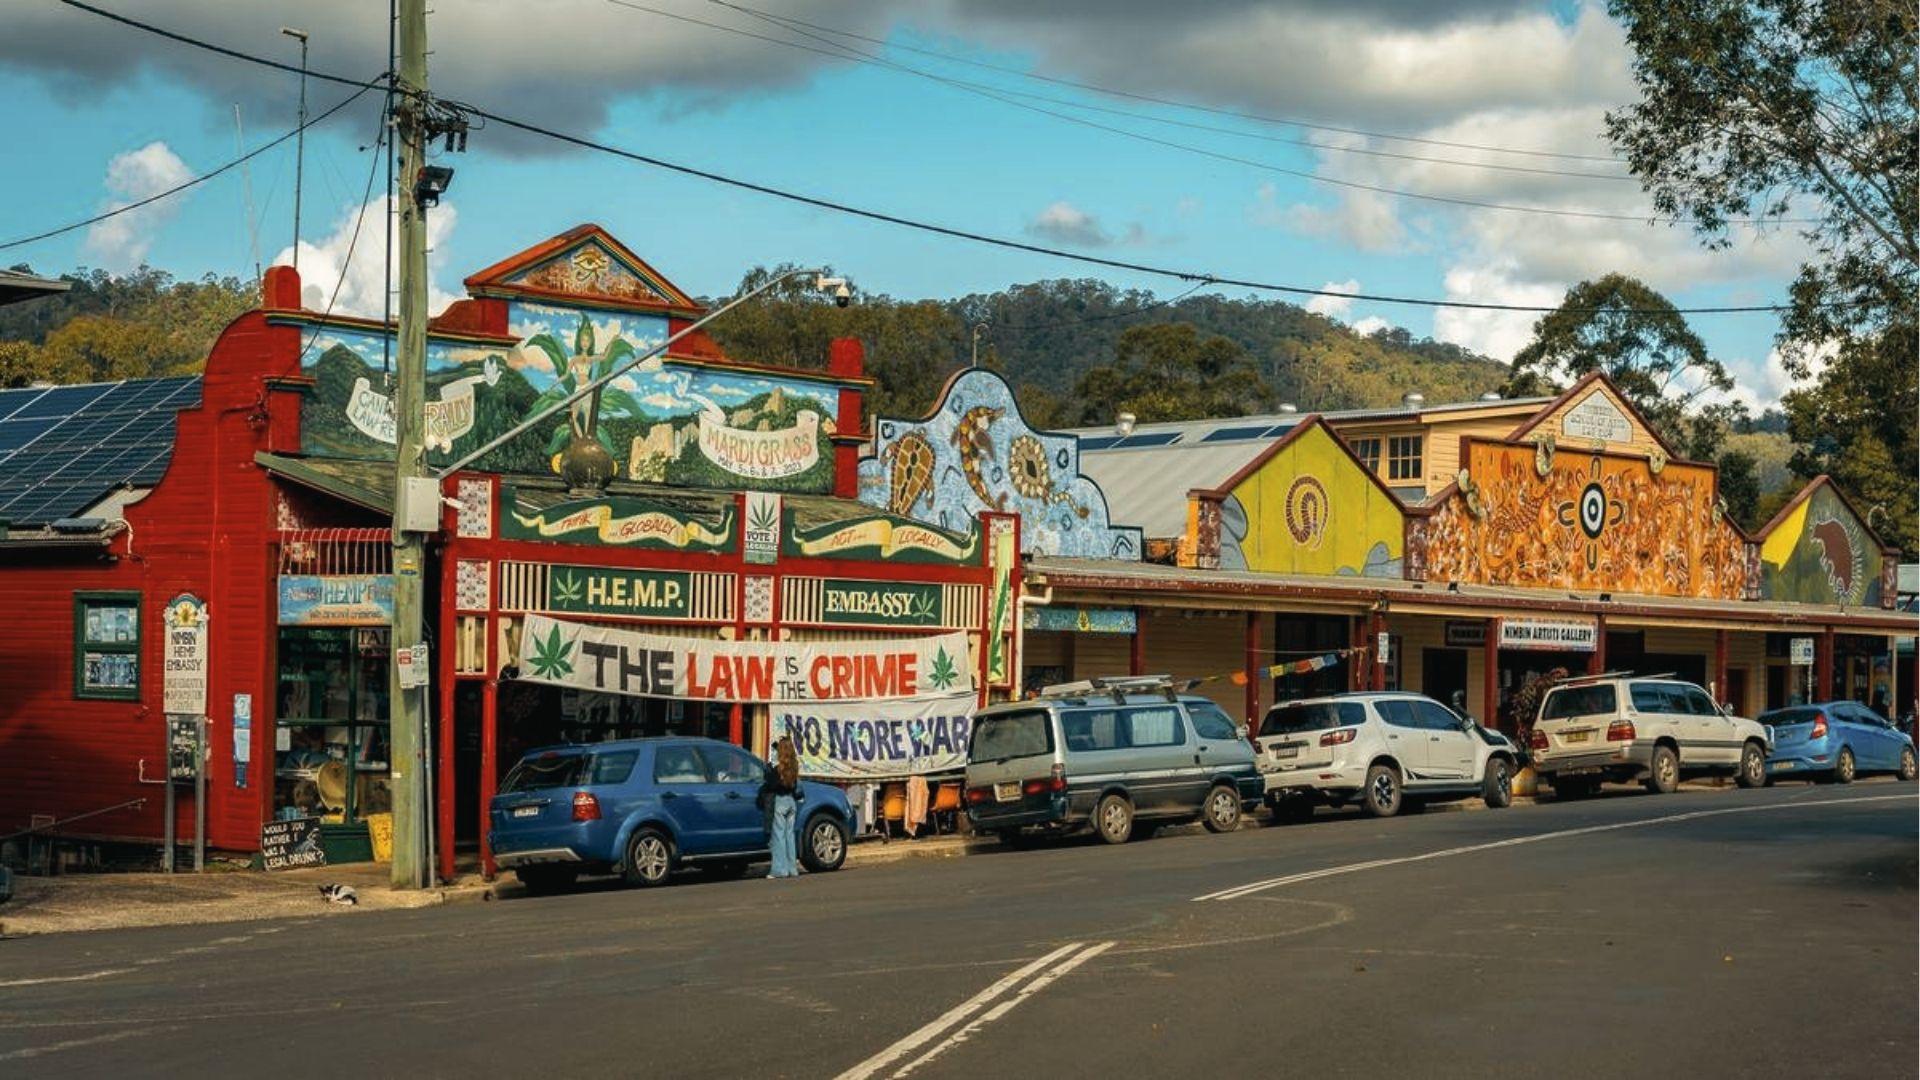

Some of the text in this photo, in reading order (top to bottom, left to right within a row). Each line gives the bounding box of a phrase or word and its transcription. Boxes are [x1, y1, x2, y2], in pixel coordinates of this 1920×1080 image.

[424, 395, 473, 438] RALLY
[706, 426, 812, 466] MARDI GRASS
[621, 518, 677, 537] GLOBALLY
[747, 531, 771, 542] VOTE
[898, 529, 945, 549] LOCALLY
[586, 576, 684, 609] H.E.M.P.
[825, 589, 917, 617] EMBASSY
[171, 631, 197, 646] NIMBIN
[1503, 625, 1532, 639] NIMBIN
[1561, 627, 1593, 642] GALLERY
[174, 645, 196, 658] HEMP
[166, 658, 203, 672] EMBASSY
[582, 639, 918, 701] THE LAW IS THE CRIME
[783, 713, 970, 762] NO MORE WAR
[263, 821, 305, 835] WOULD YOU
[263, 834, 291, 847] RATHER
[263, 845, 286, 857] WAS A
[263, 856, 290, 872] LEGAL
